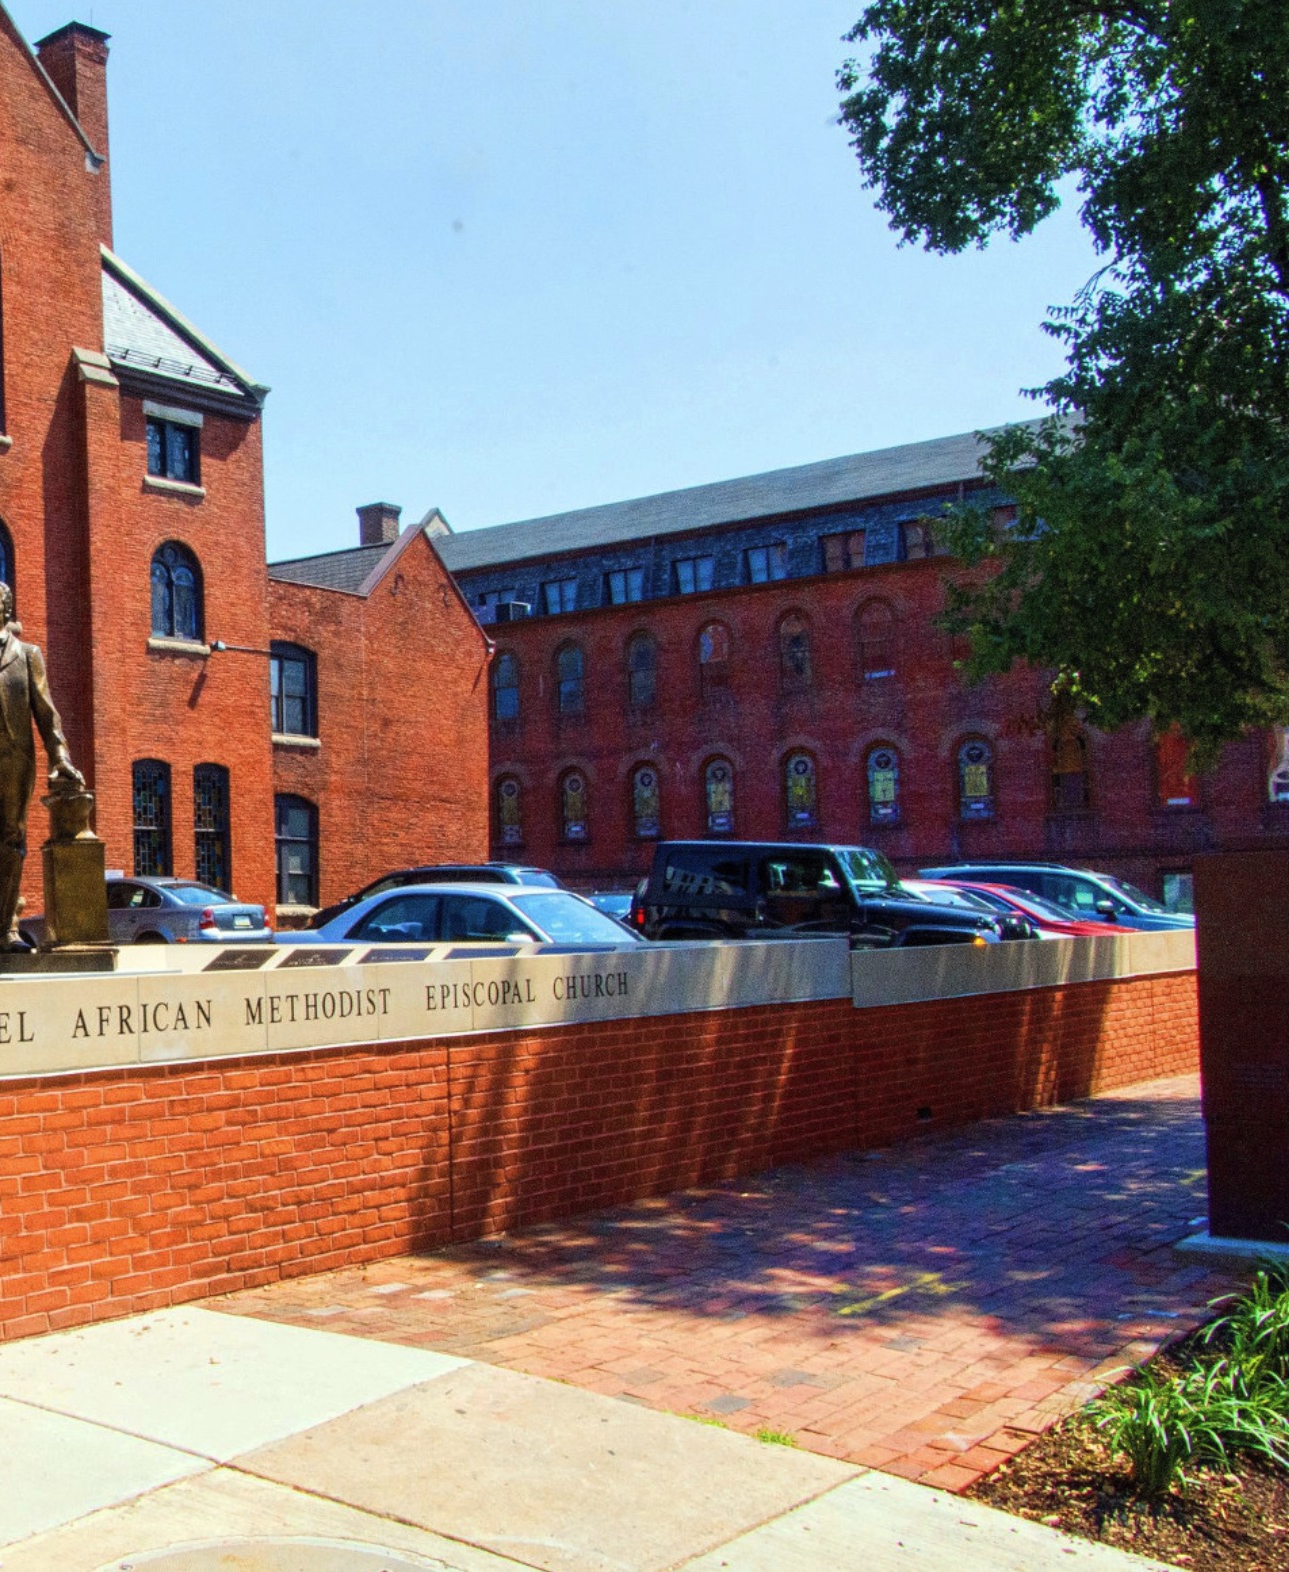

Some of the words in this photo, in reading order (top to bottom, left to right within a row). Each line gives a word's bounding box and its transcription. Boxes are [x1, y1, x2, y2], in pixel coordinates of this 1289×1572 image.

[71, 999, 214, 1039] AFRICAN
[244, 987, 392, 1026] METHODIST
[425, 978, 536, 1012] EPISCOPAL
[553, 971, 629, 1001] CHURCH
